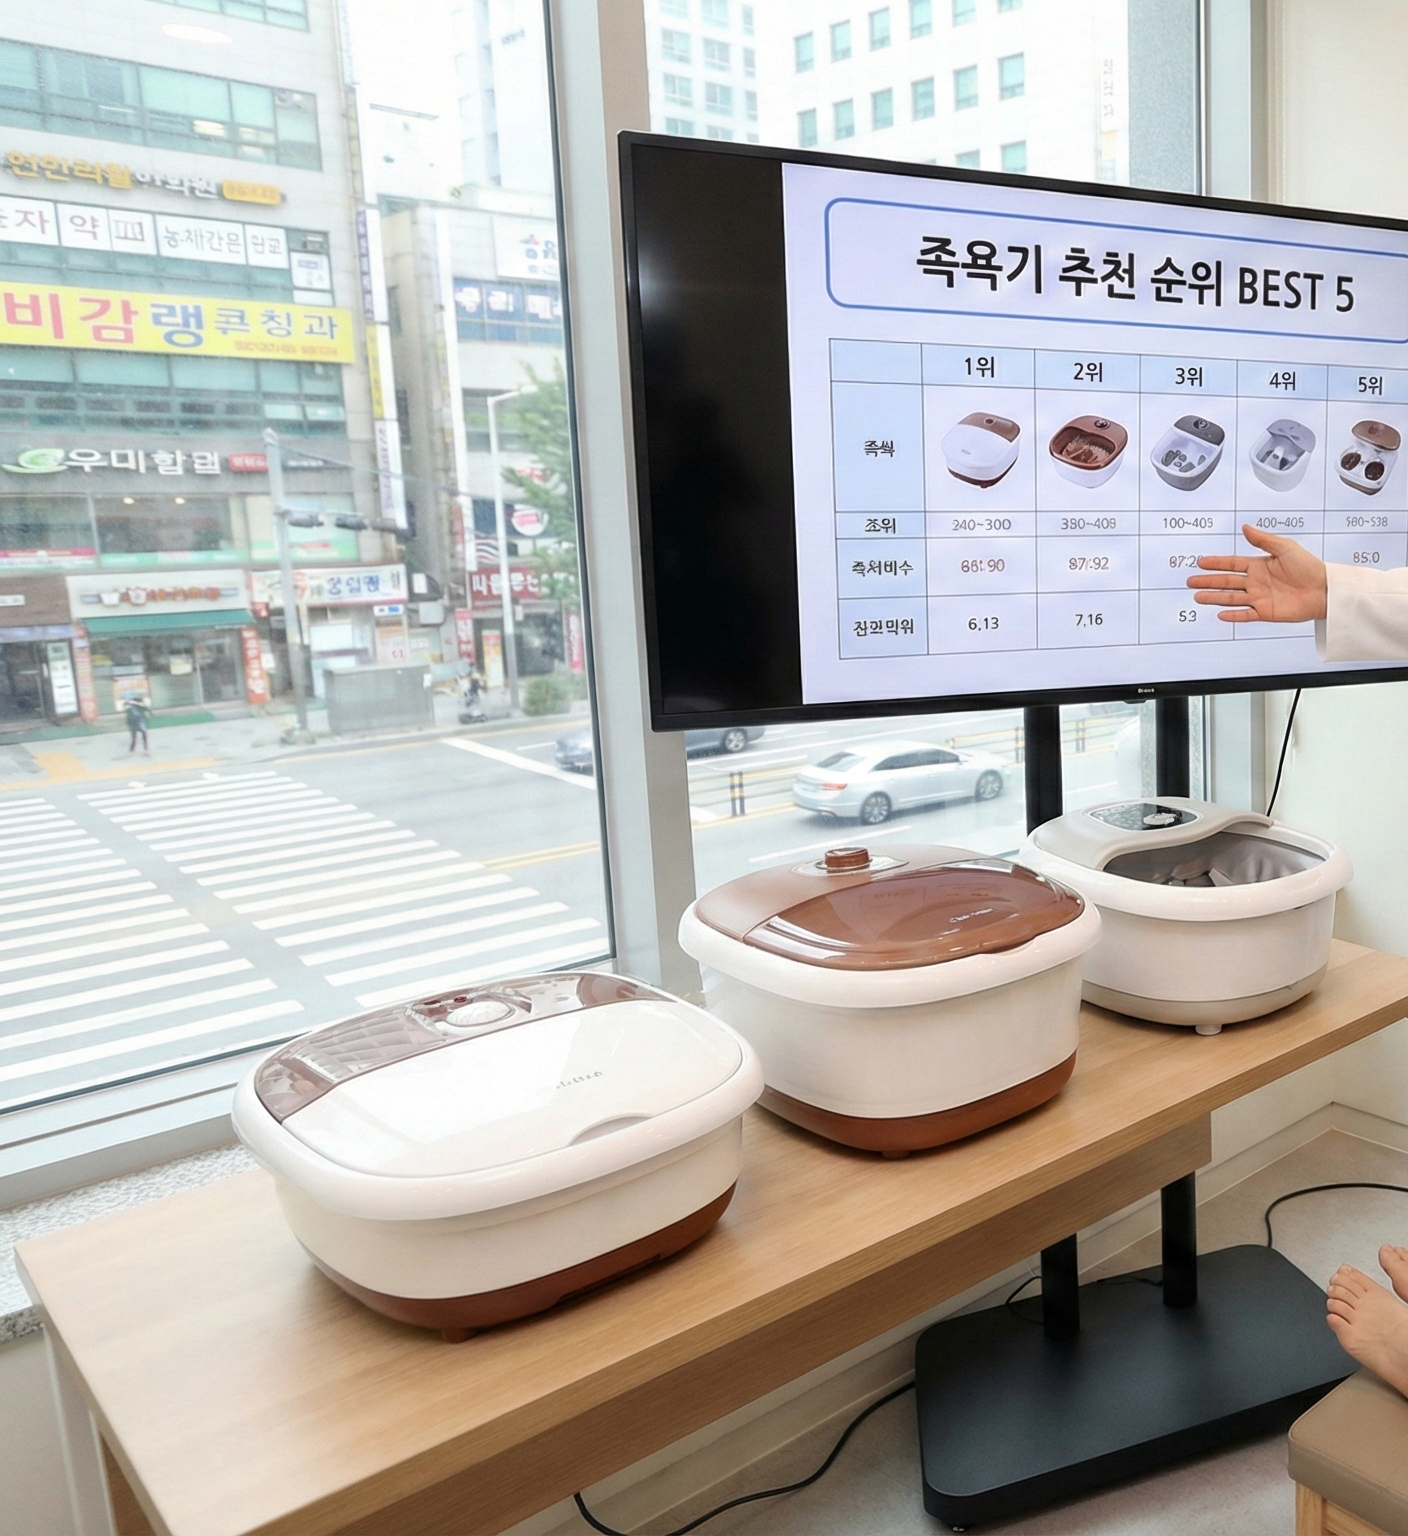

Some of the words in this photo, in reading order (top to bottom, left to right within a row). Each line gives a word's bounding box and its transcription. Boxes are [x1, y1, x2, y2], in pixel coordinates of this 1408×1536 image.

[916, 235, 1042, 295] 족욕기
[1058, 247, 1136, 300] 추천
[1150, 256, 1222, 307] 순위
[1238, 266, 1324, 311] BEST
[1335, 275, 1355, 313] 5
[964, 356, 995, 379] 1위
[1073, 362, 1103, 383] 2위
[1175, 366, 1203, 387] 3위
[1269, 371, 1296, 391] 4위
[1358, 375, 1383, 396] 5위
